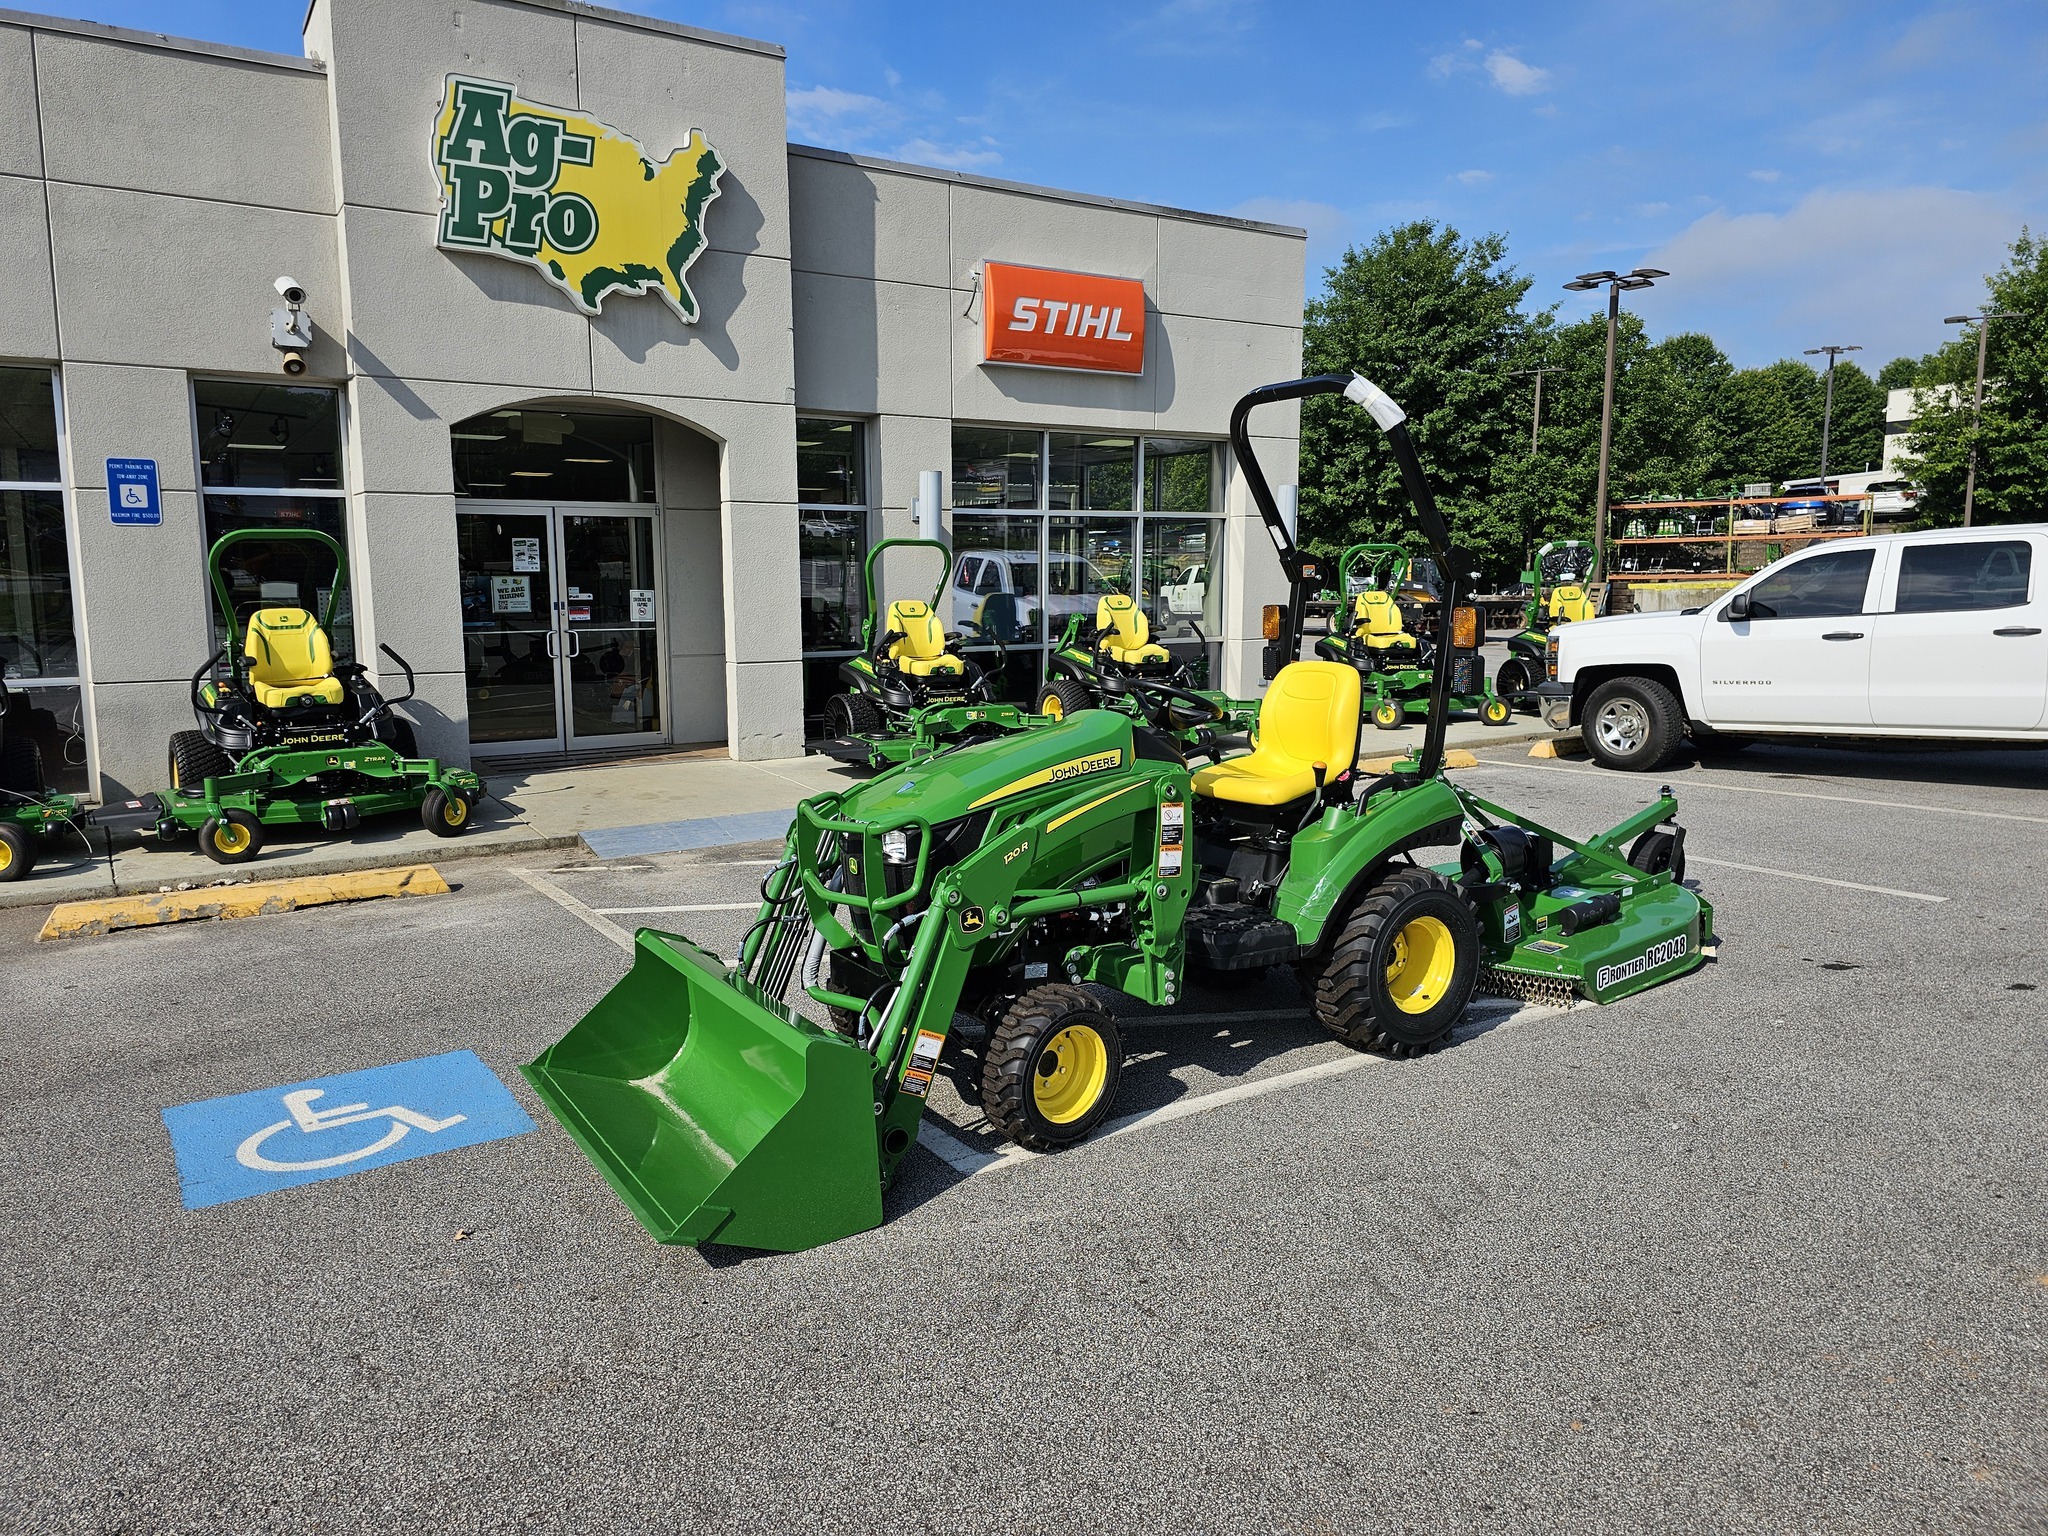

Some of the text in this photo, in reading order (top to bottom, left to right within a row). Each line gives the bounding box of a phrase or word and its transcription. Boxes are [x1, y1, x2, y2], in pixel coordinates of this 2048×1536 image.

[441, 84, 593, 189] Ag-
[446, 164, 597, 252] Pro
[1008, 296, 1132, 341] STIHL
[497, 585, 526, 595] WE ARE
[498, 592, 526, 600] HIRING
[1400, 663, 1418, 671] DEERE
[926, 695, 966, 704] JOHN DEERE
[280, 733, 345, 746] JOHN DEERE
[364, 755, 386, 763] ZTRAK
[1048, 756, 1117, 783] JOHN DEERE
[1598, 935, 1686, 989] FRONTIER RC2048
